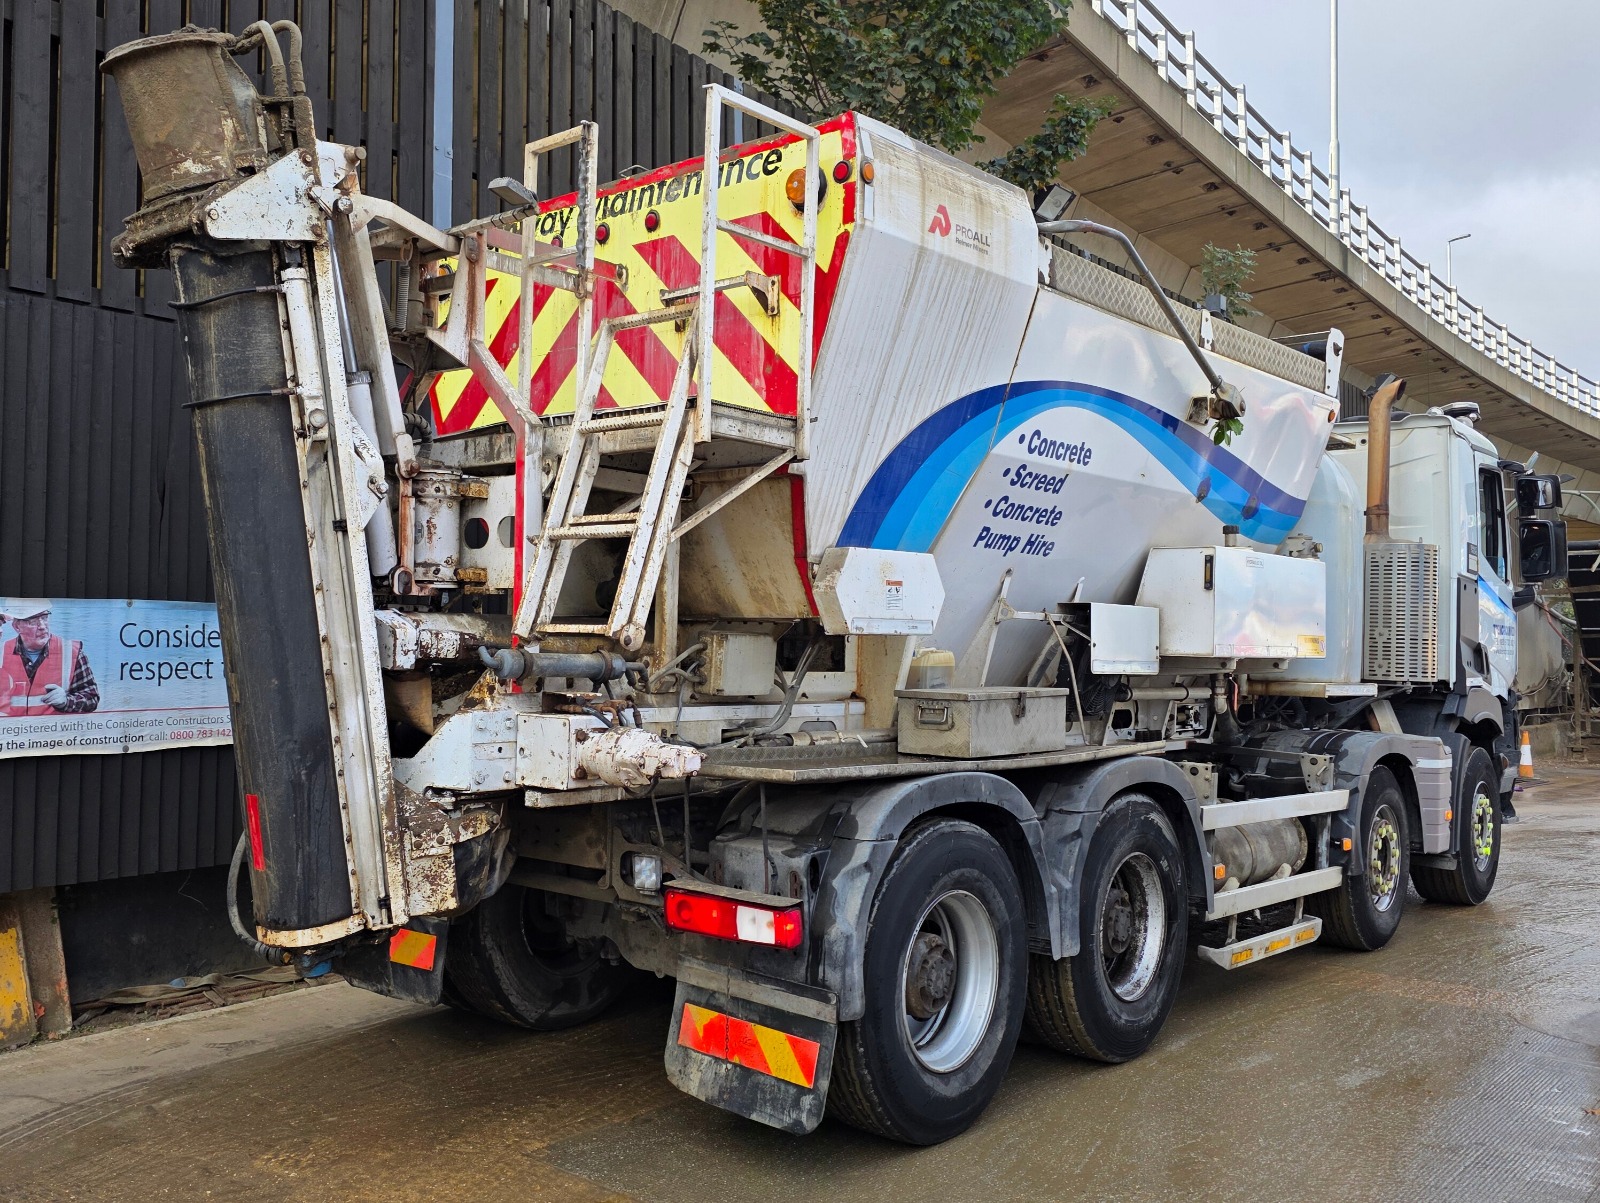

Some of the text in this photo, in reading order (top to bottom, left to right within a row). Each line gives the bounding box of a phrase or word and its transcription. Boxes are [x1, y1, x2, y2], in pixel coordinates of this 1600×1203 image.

[955, 224, 991, 248] PROALL
[1027, 429, 1092, 466] Concrete
[1009, 463, 1070, 495] Screed
[991, 495, 1063, 527] Concrete
[973, 525, 1056, 557] Pump Hire
[120, 658, 214, 687] respect
[2, 722, 58, 737] registered
[60, 721, 84, 732] with
[86, 720, 104, 731] the
[105, 718, 164, 730] Considerate
[165, 715, 224, 726] Constructors
[6, 739, 26, 750] the
[28, 738, 63, 750] image
[66, 735, 78, 747] of
[79, 733, 144, 746] construction
[149, 731, 168, 742] call:
[169, 730, 194, 740] 0800
[196, 728, 213, 739] 783
